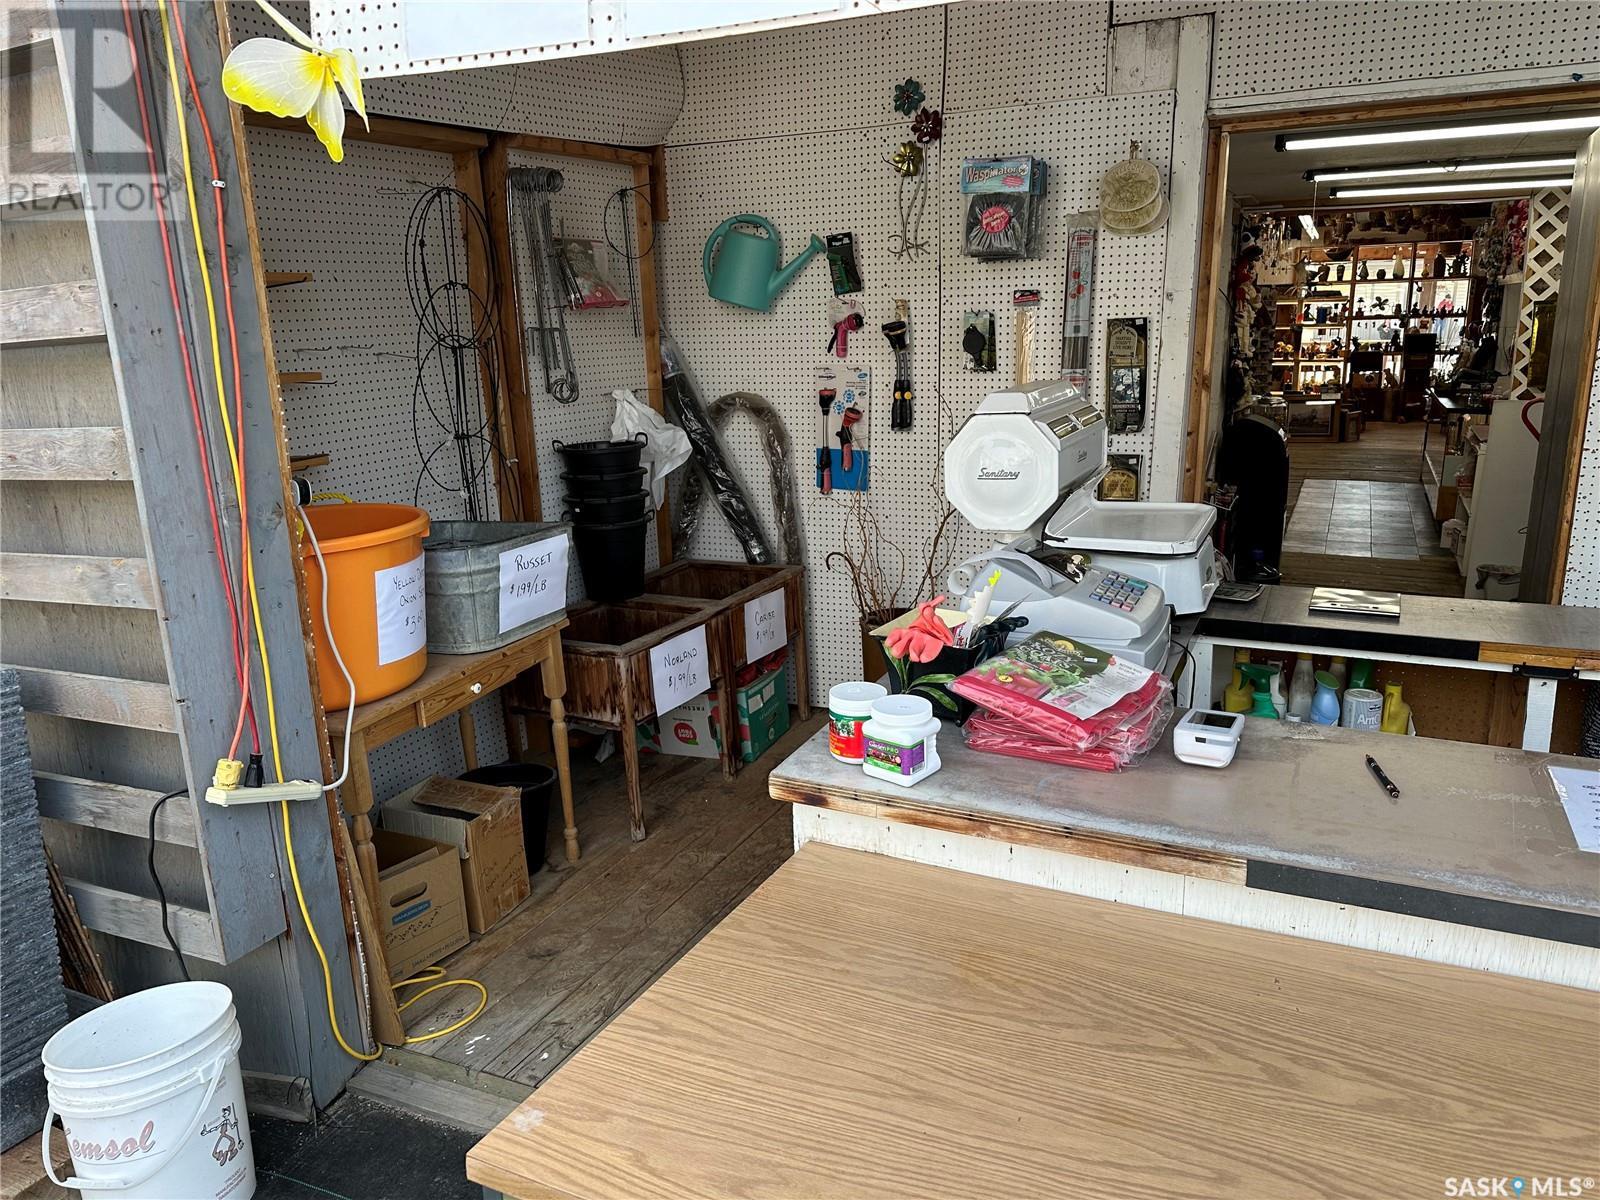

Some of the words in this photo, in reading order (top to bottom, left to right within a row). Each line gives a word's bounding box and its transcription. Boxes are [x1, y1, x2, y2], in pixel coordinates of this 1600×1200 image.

[965, 166, 1017, 183] Waspinator
[977, 467, 1021, 480] Sanitary
[65, 1120, 157, 1160] emsol
